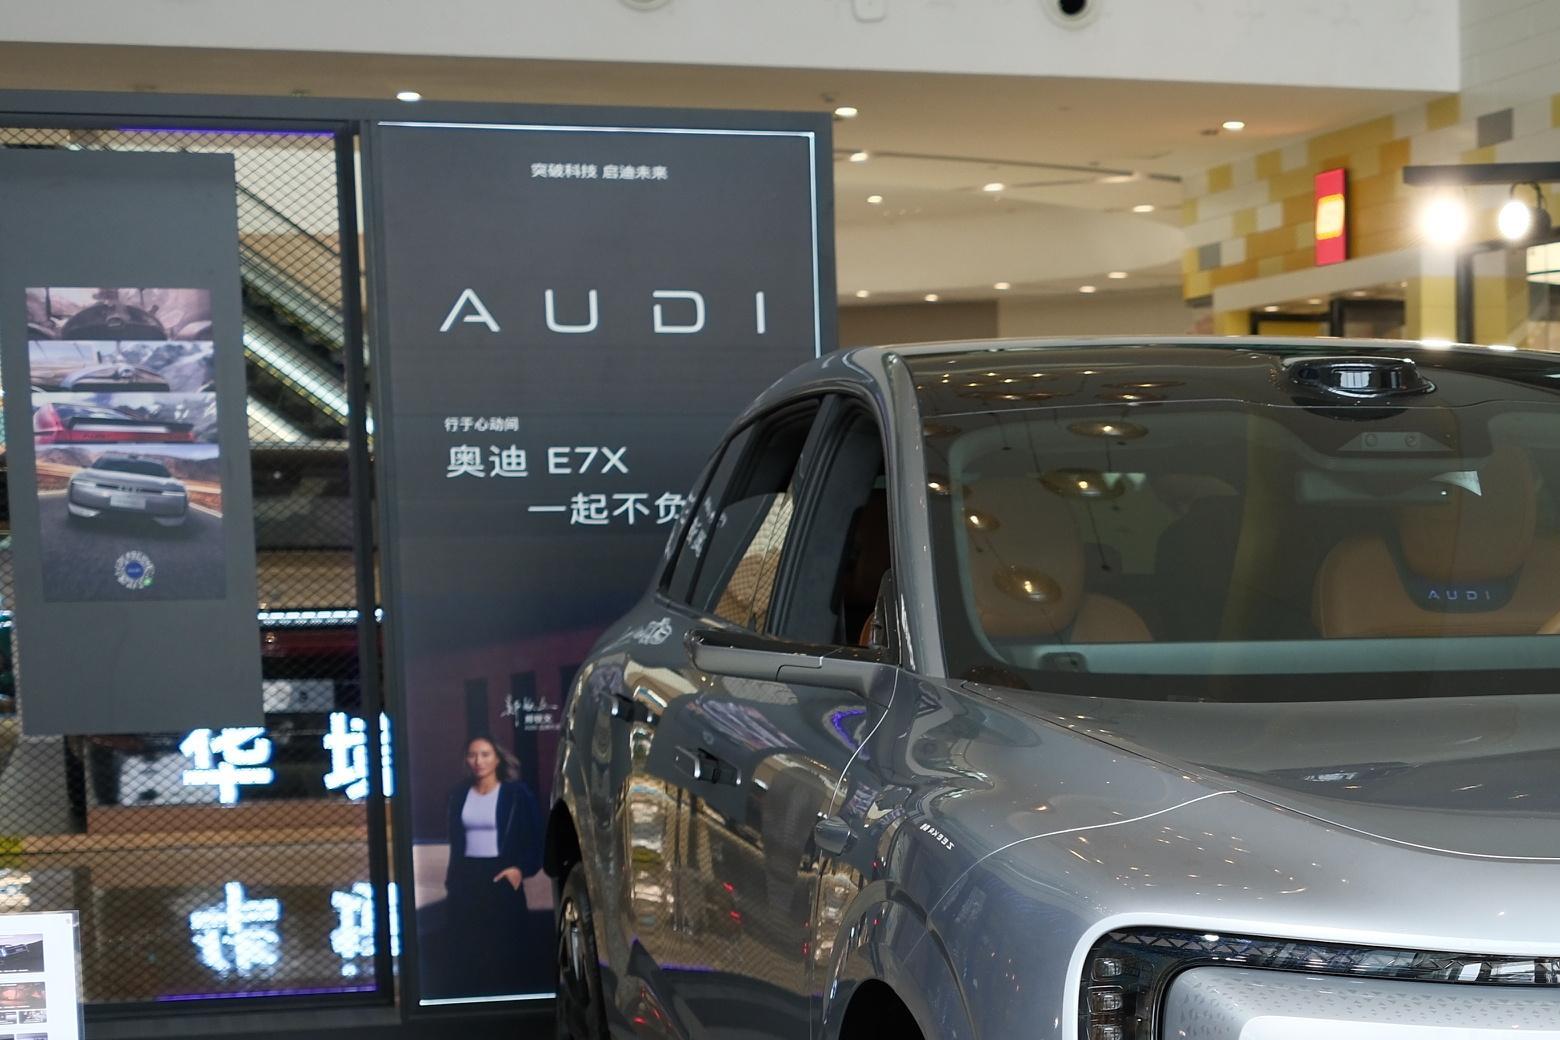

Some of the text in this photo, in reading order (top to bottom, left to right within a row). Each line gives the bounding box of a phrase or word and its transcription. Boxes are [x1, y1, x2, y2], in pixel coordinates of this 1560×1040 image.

[530, 162, 669, 181] 突破科技 启迪未来
[439, 288, 766, 334] AUDI
[446, 444, 630, 478] 奥迪 E7X
[1427, 589, 1491, 601] AUDI
